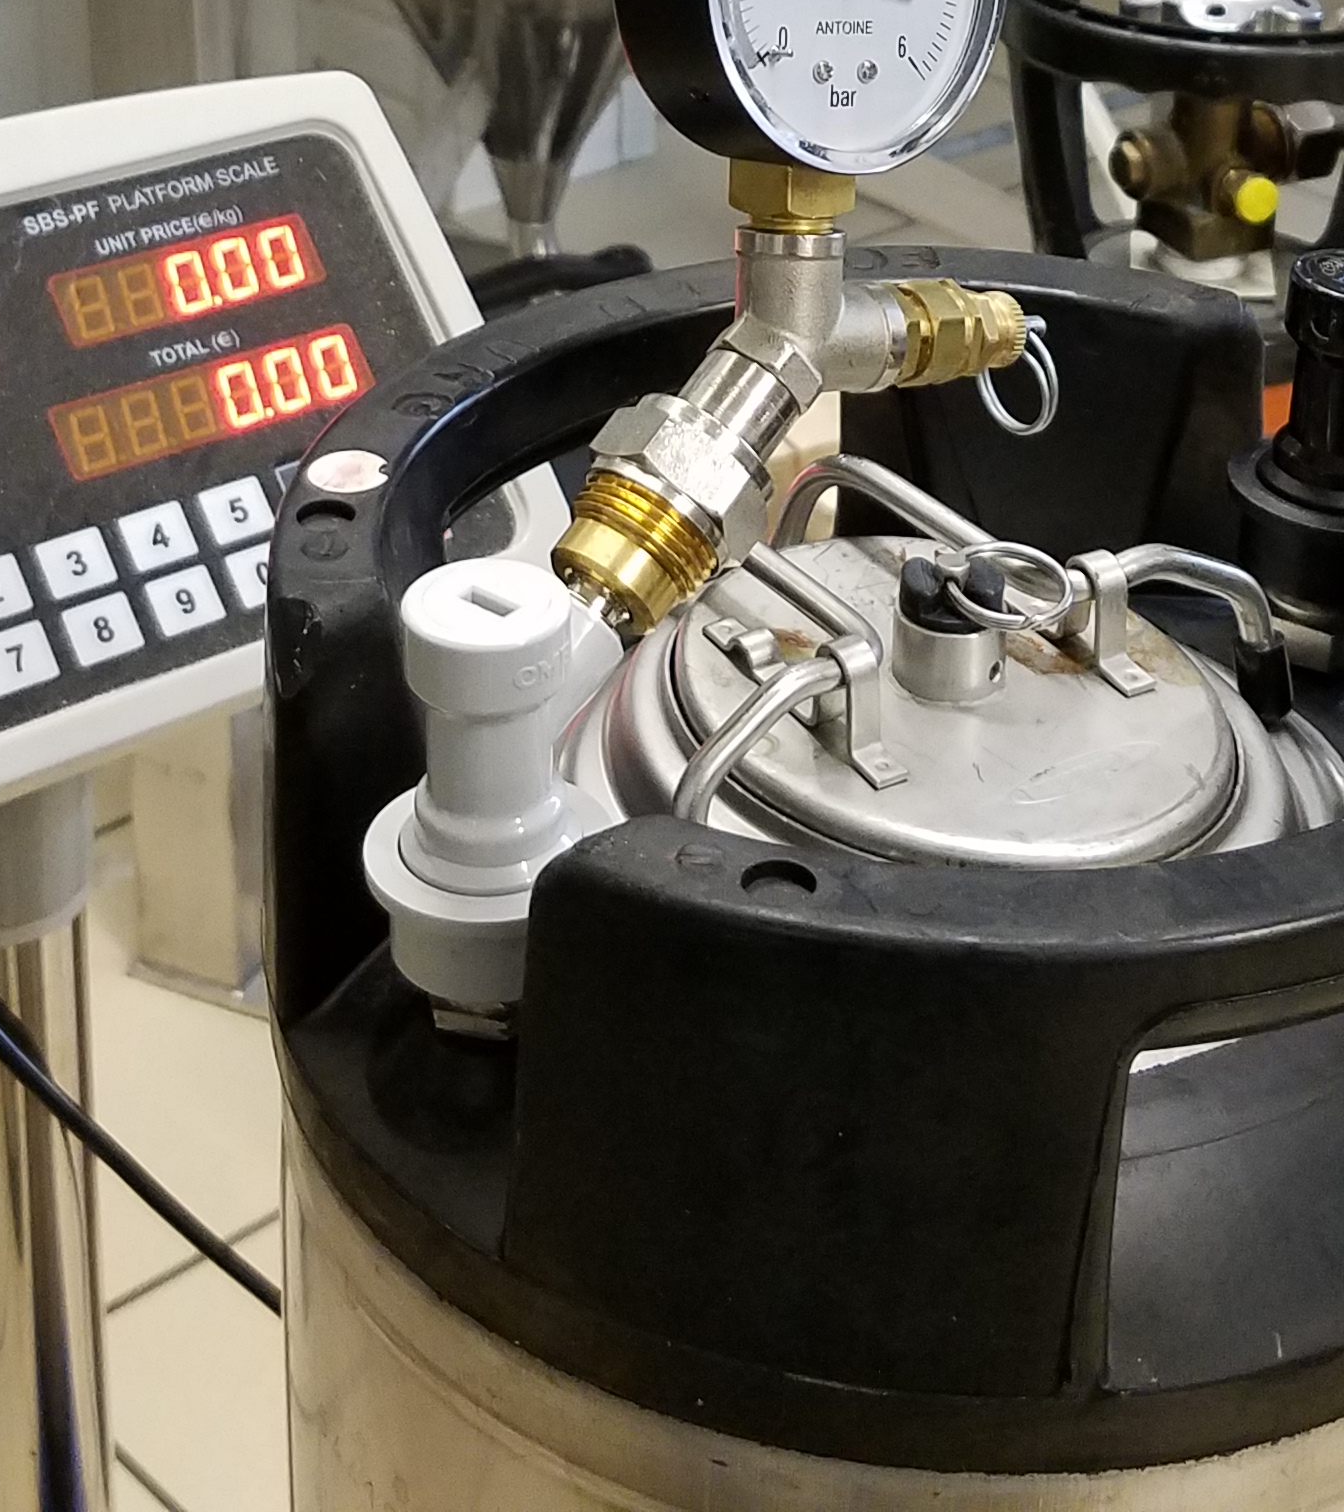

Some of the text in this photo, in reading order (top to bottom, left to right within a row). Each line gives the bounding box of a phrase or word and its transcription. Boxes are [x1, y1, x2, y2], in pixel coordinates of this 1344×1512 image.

[778, 26, 788, 49] 0
[815, 20, 873, 36] ANTOINE
[898, 36, 908, 59] 6
[830, 85, 857, 108] bar
[21, 155, 280, 236] SBS-PF PLATFORM SCALE
[94, 230, 138, 257] UNIT
[164, 224, 306, 316] 0.00
[149, 340, 210, 368] TOTAL
[215, 334, 358, 429] 0.00
[228, 497, 249, 524] 5
[151, 522, 171, 549] 4
[65, 550, 88, 577] 3
[174, 588, 197, 614] 9
[92, 616, 115, 643] 8
[5, 643, 26, 673] 7
